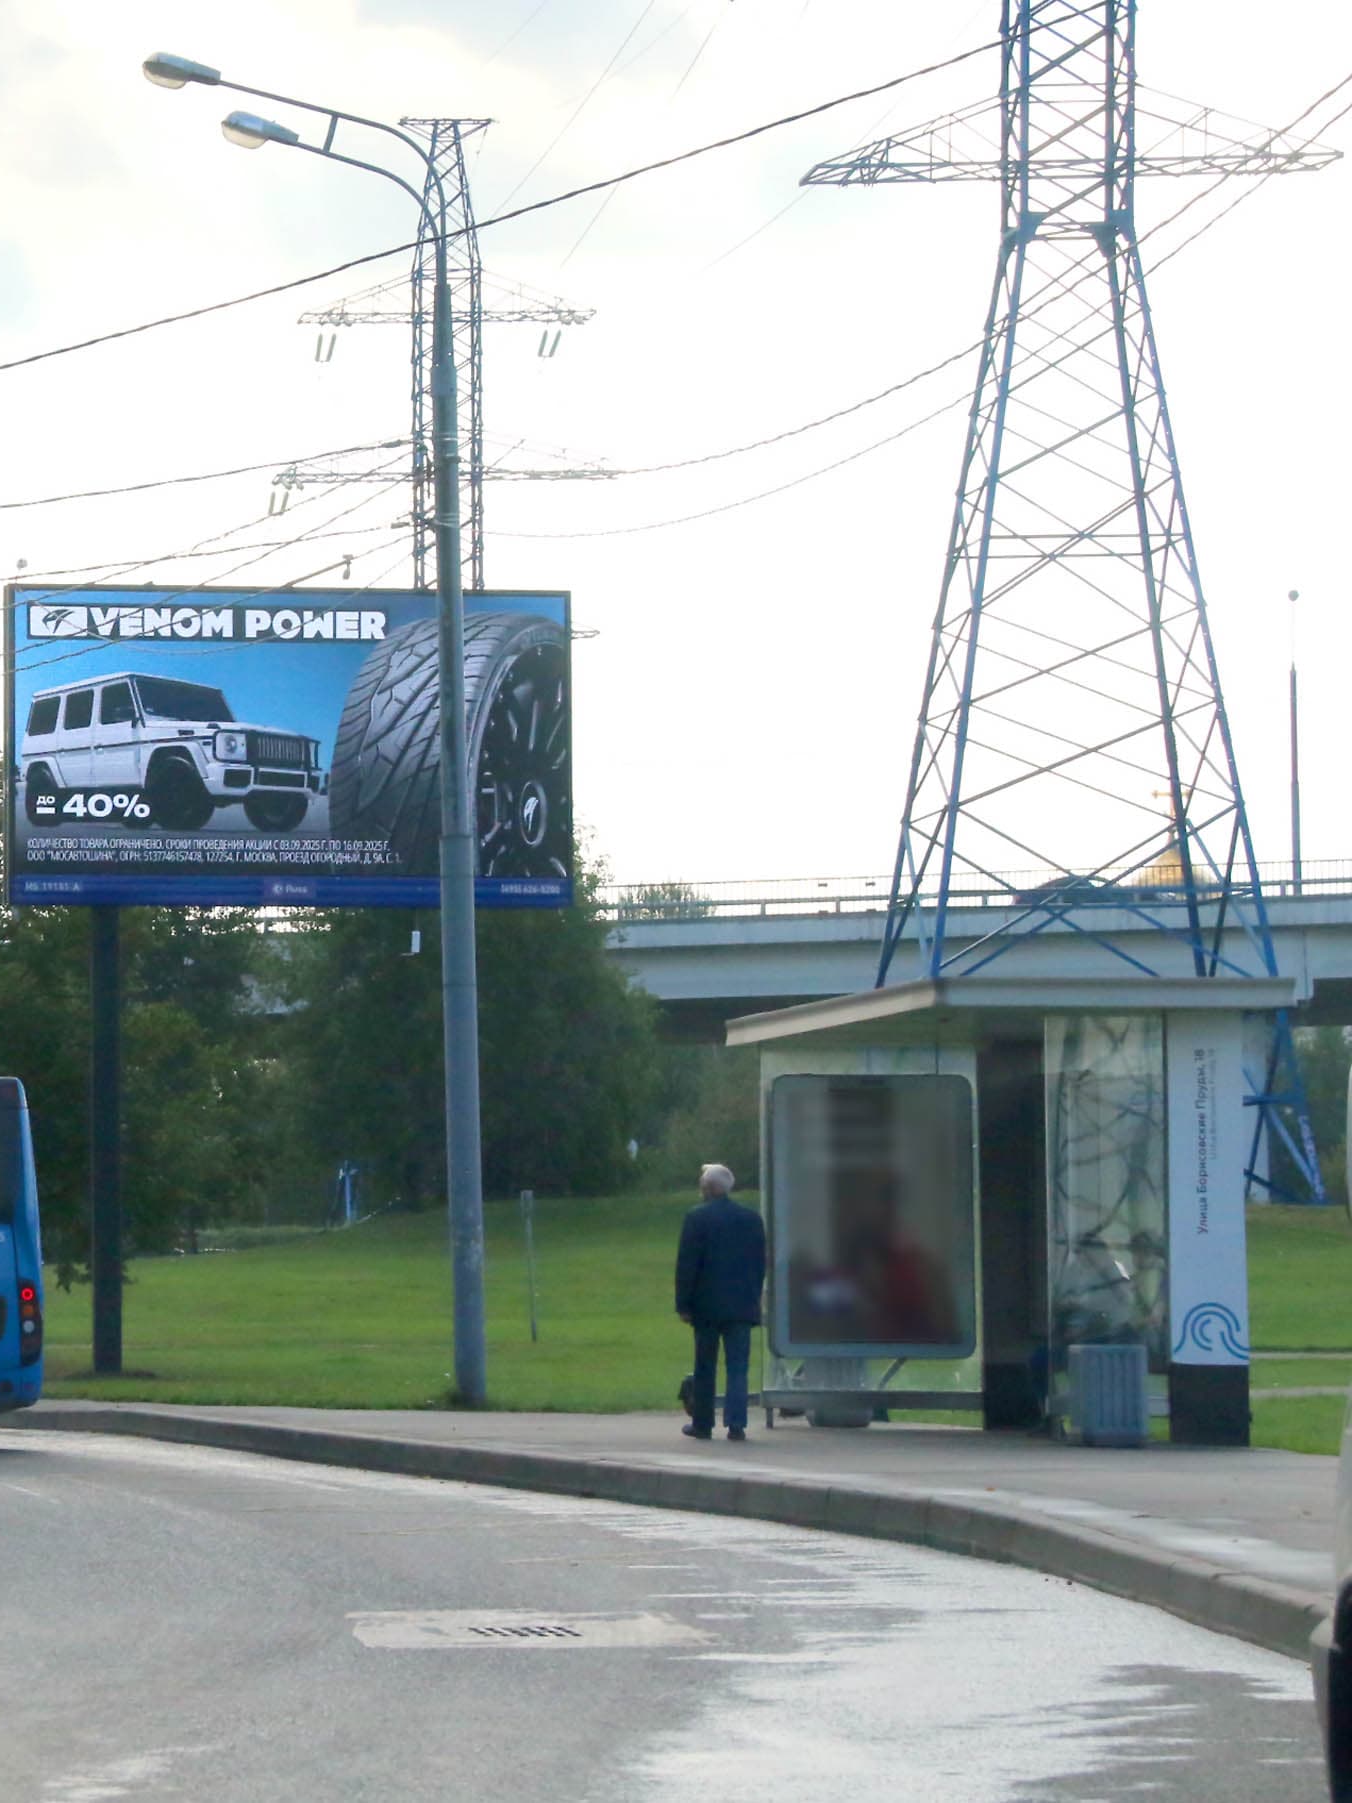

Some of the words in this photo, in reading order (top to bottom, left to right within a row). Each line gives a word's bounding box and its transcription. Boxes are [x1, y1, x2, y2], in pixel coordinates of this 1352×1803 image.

[89, 606, 234, 638] VENOM
[244, 609, 387, 640] POWER
[27, 838, 78, 849] КОЛИЧЕСТВО
[80, 838, 109, 849] ТОВАРА
[166, 839, 191, 850] СРОКИ
[193, 839, 245, 851] ПРОВЕДЕНИЯ
[245, 839, 272, 851] АКЦИИ
[280, 840, 320, 850] 03.09.2025
[330, 840, 341, 850] ПО
[27, 851, 46, 861] ООО
[280, 852, 309, 864] ПРОЕЗД
[1196, 1111, 1209, 1194] Борисовские
[1197, 1195, 1209, 1235] Улица
